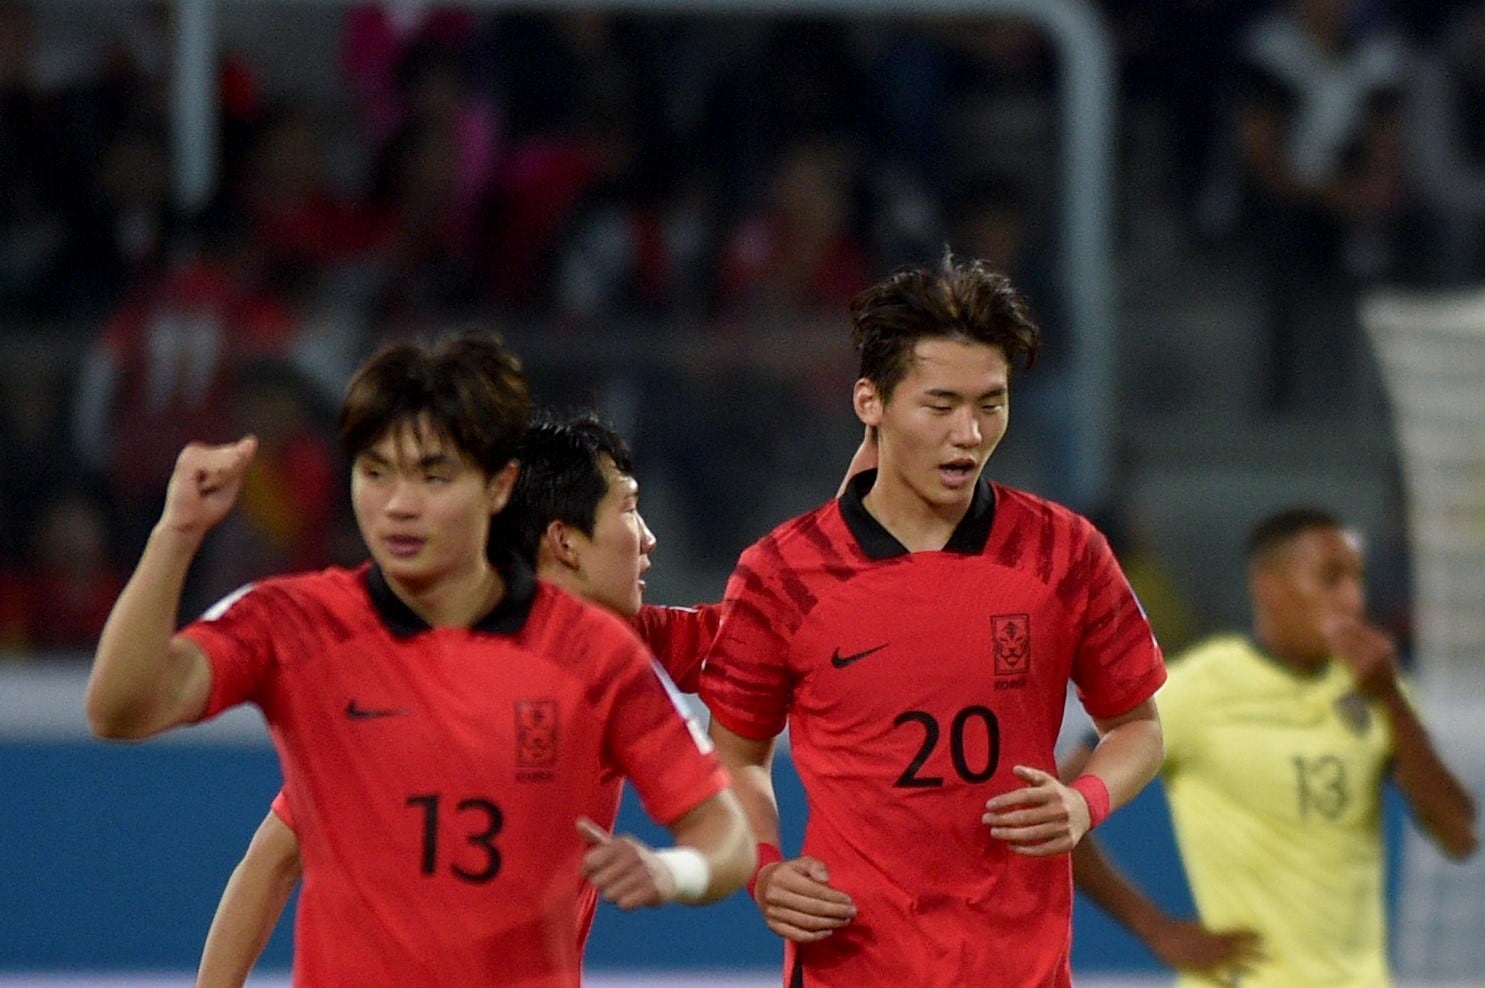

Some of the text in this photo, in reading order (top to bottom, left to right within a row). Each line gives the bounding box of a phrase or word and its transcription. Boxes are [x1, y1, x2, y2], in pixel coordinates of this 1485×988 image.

[892, 705, 1000, 788] 20
[1293, 754, 1347, 821] 13
[406, 794, 505, 885] 13
